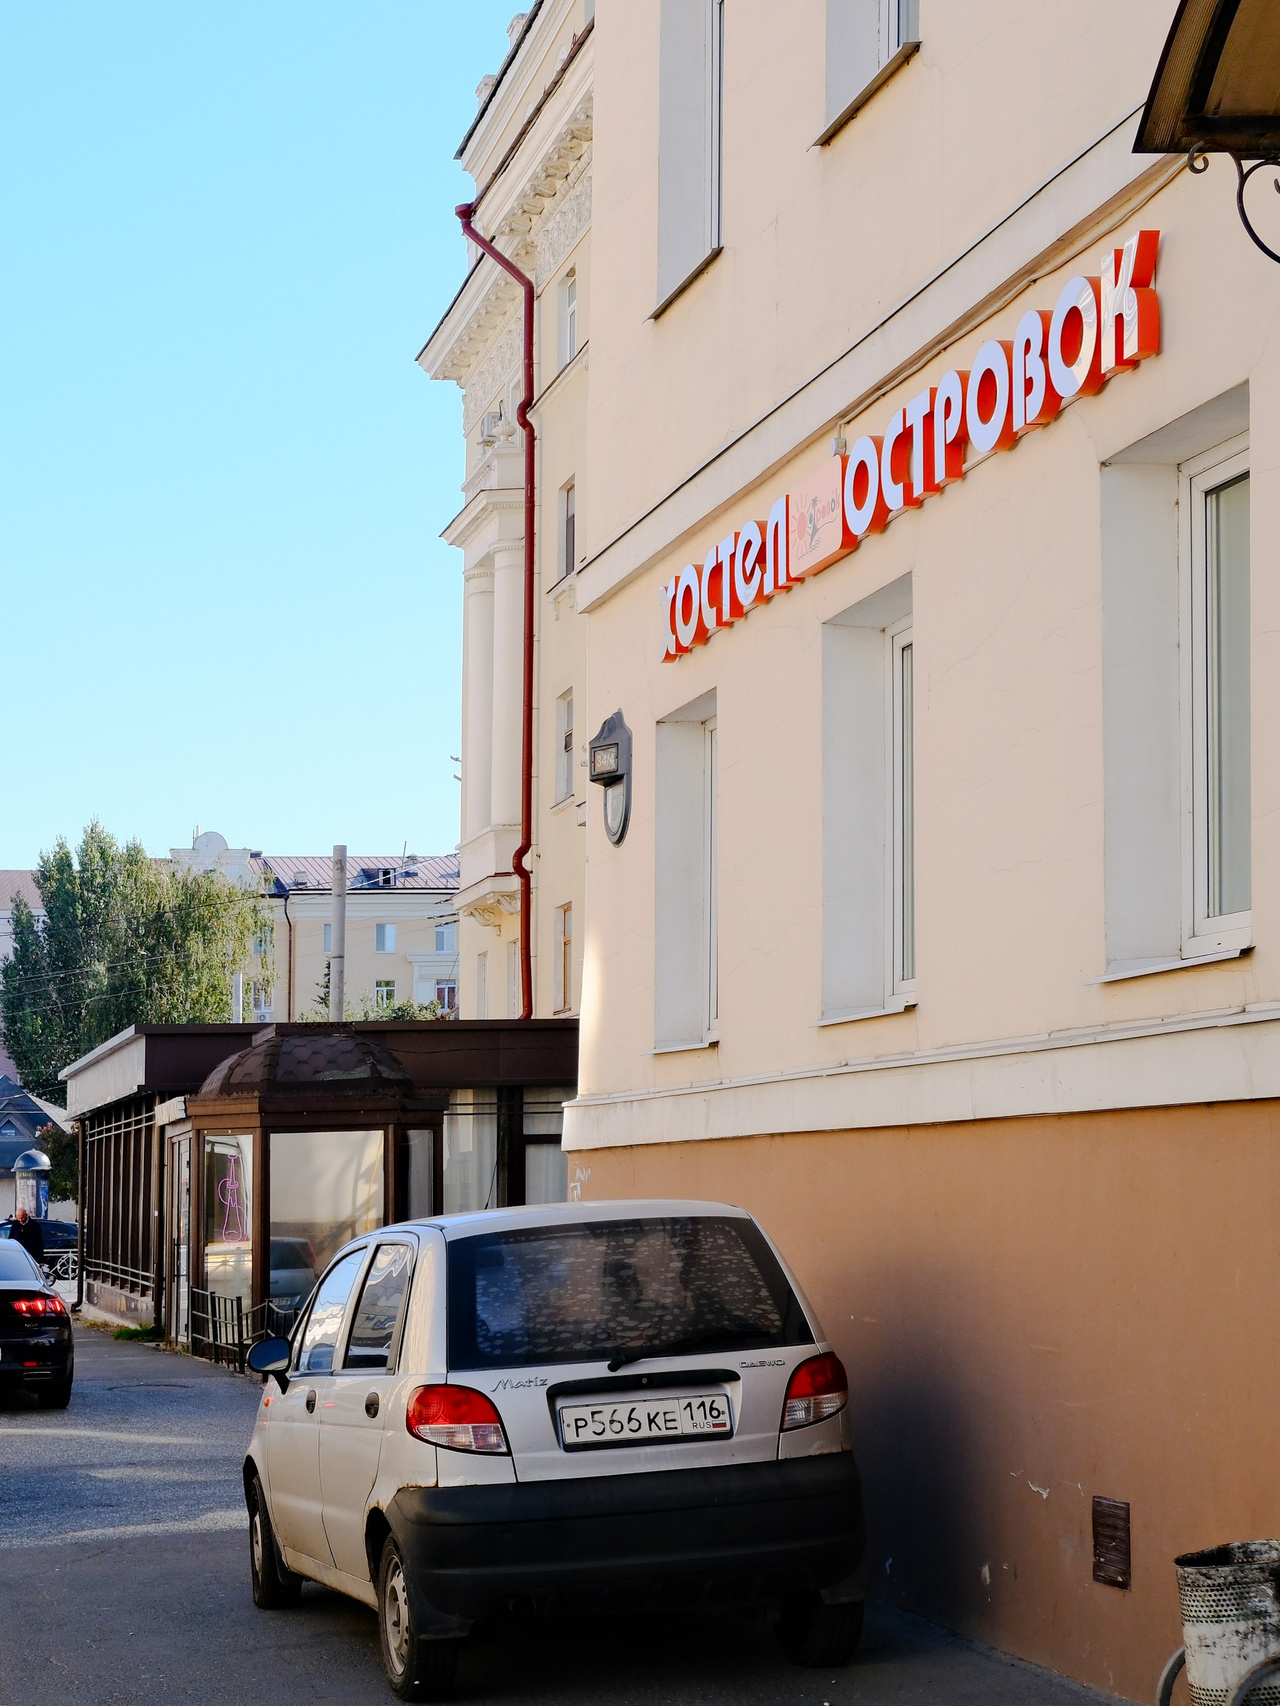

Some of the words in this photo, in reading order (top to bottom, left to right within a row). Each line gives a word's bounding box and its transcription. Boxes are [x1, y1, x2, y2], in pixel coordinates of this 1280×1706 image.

[844, 231, 1161, 536] ОСТРОВОК
[491, 1377, 548, 1392] Matiz
[683, 1400, 721, 1421] 116
[692, 1421, 712, 1430] RUS
